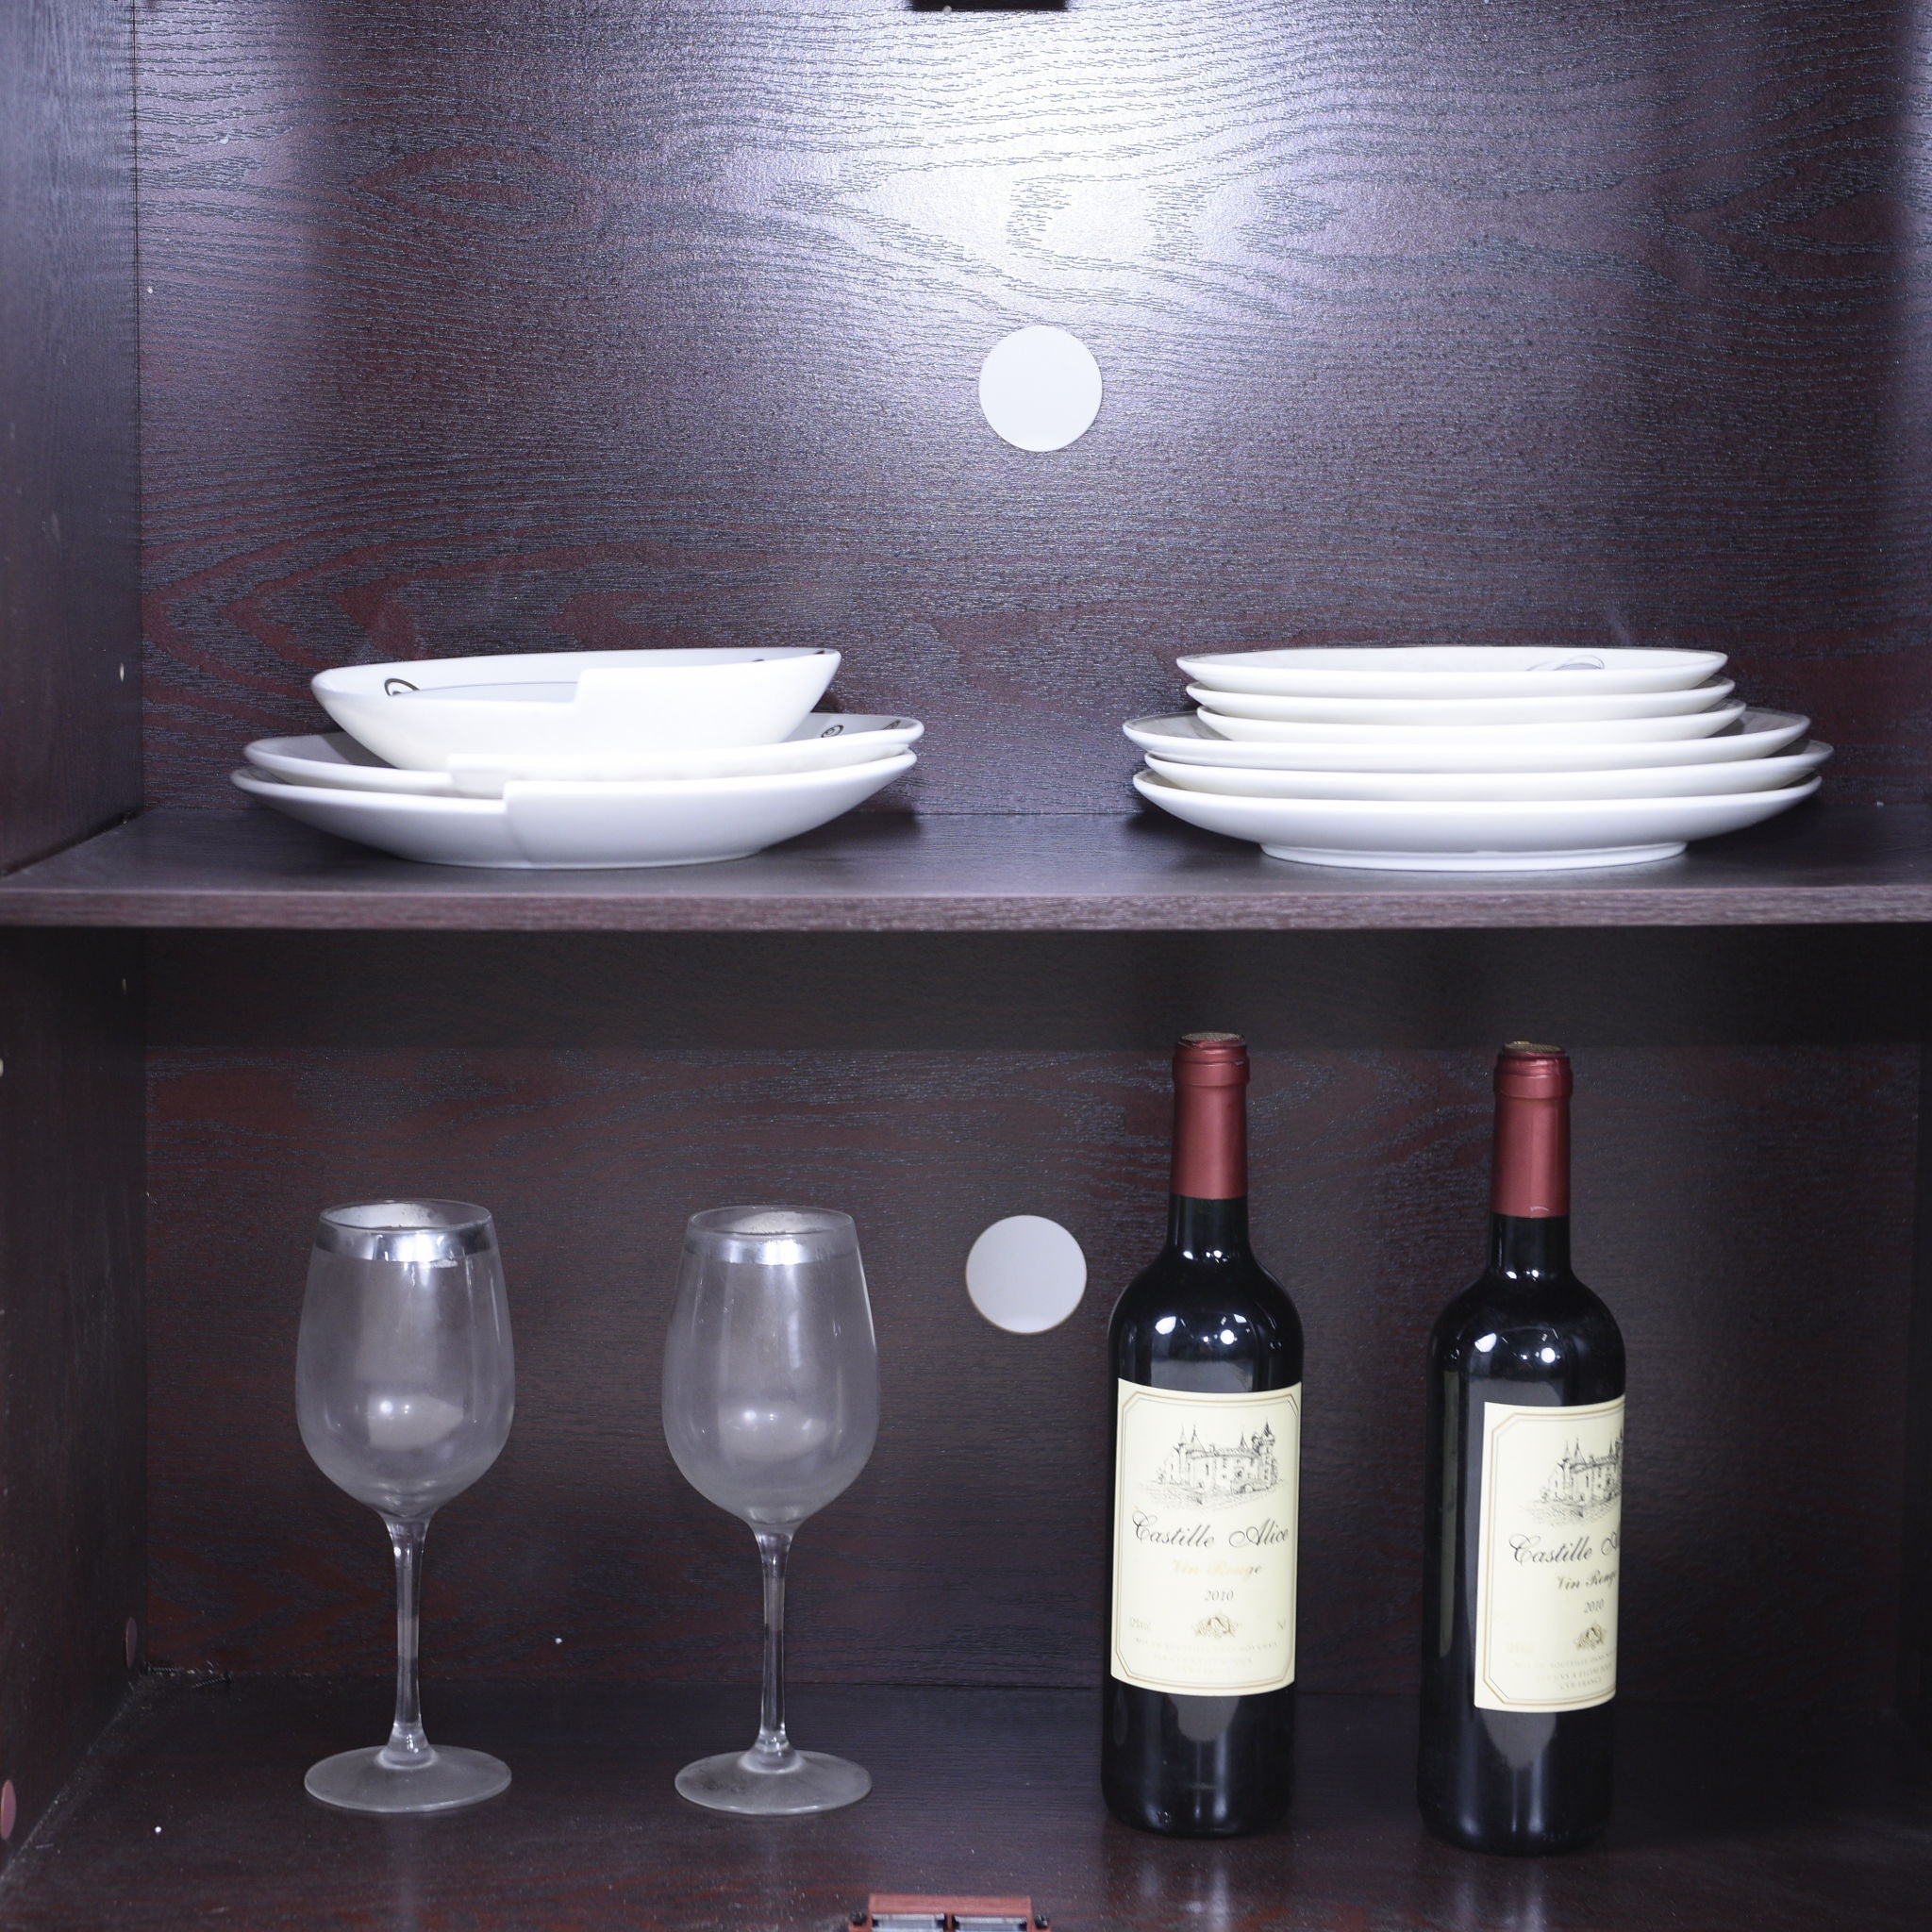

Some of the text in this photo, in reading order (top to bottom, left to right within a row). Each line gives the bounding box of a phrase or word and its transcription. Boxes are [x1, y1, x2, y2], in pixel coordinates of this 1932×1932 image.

[1132, 1510, 1290, 1548] Castille Alice
[1508, 1533, 1592, 1567] Castille
[1204, 1589, 1235, 1602] 2010
